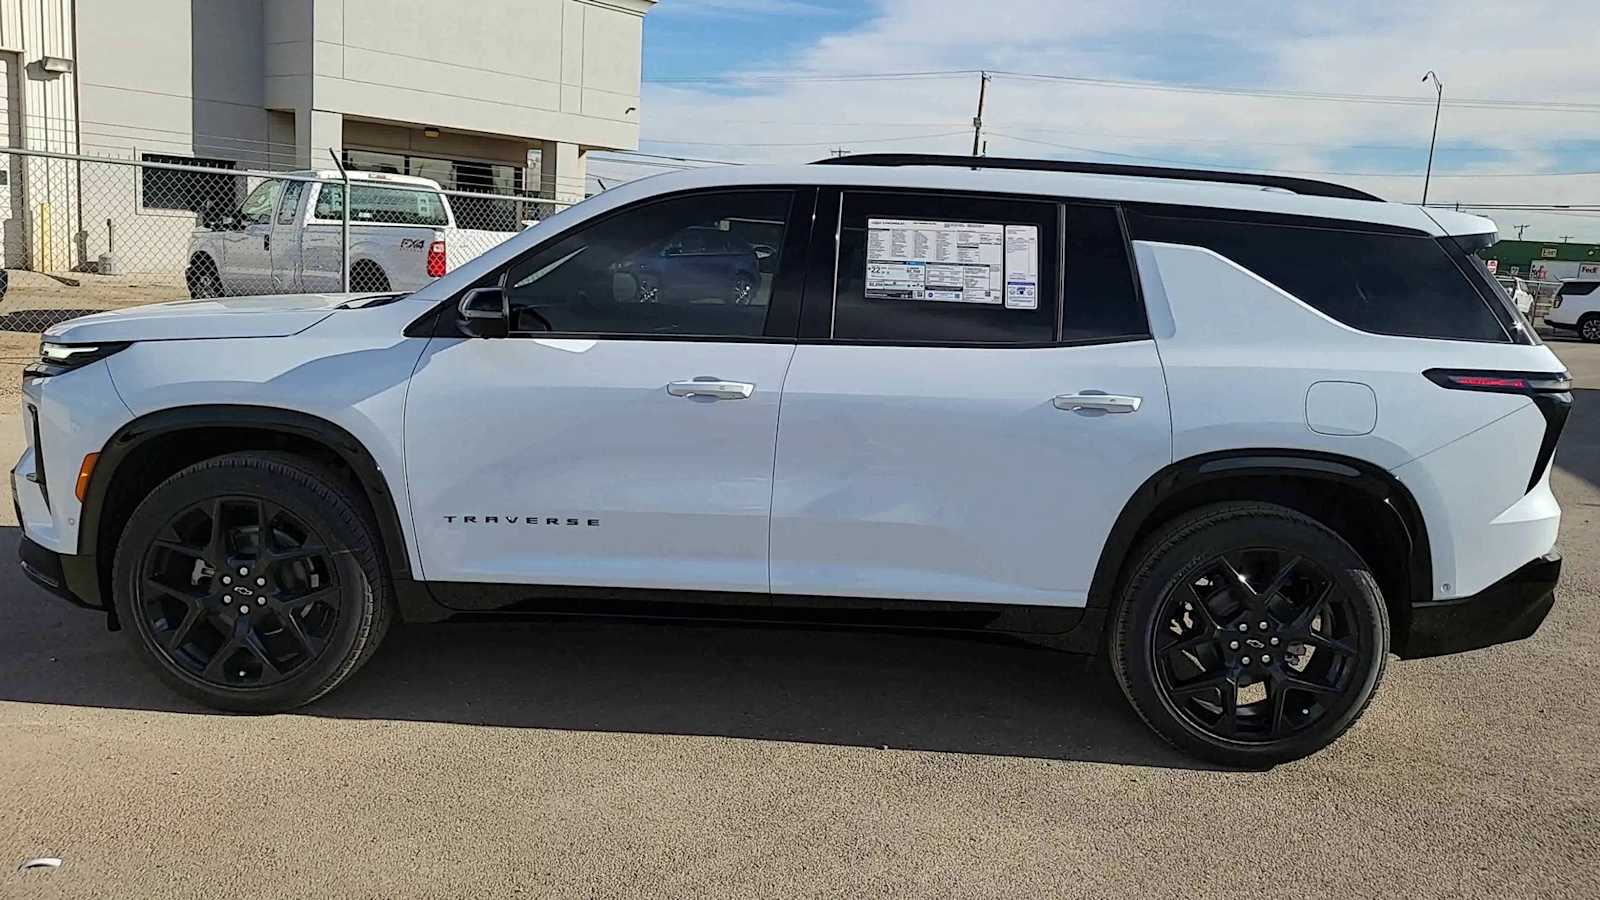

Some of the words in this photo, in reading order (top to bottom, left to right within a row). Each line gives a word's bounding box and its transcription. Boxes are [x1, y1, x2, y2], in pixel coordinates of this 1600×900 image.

[400, 238, 425, 249] FX4
[871, 264, 880, 273] 22
[443, 515, 600, 526] TRAVERSE
